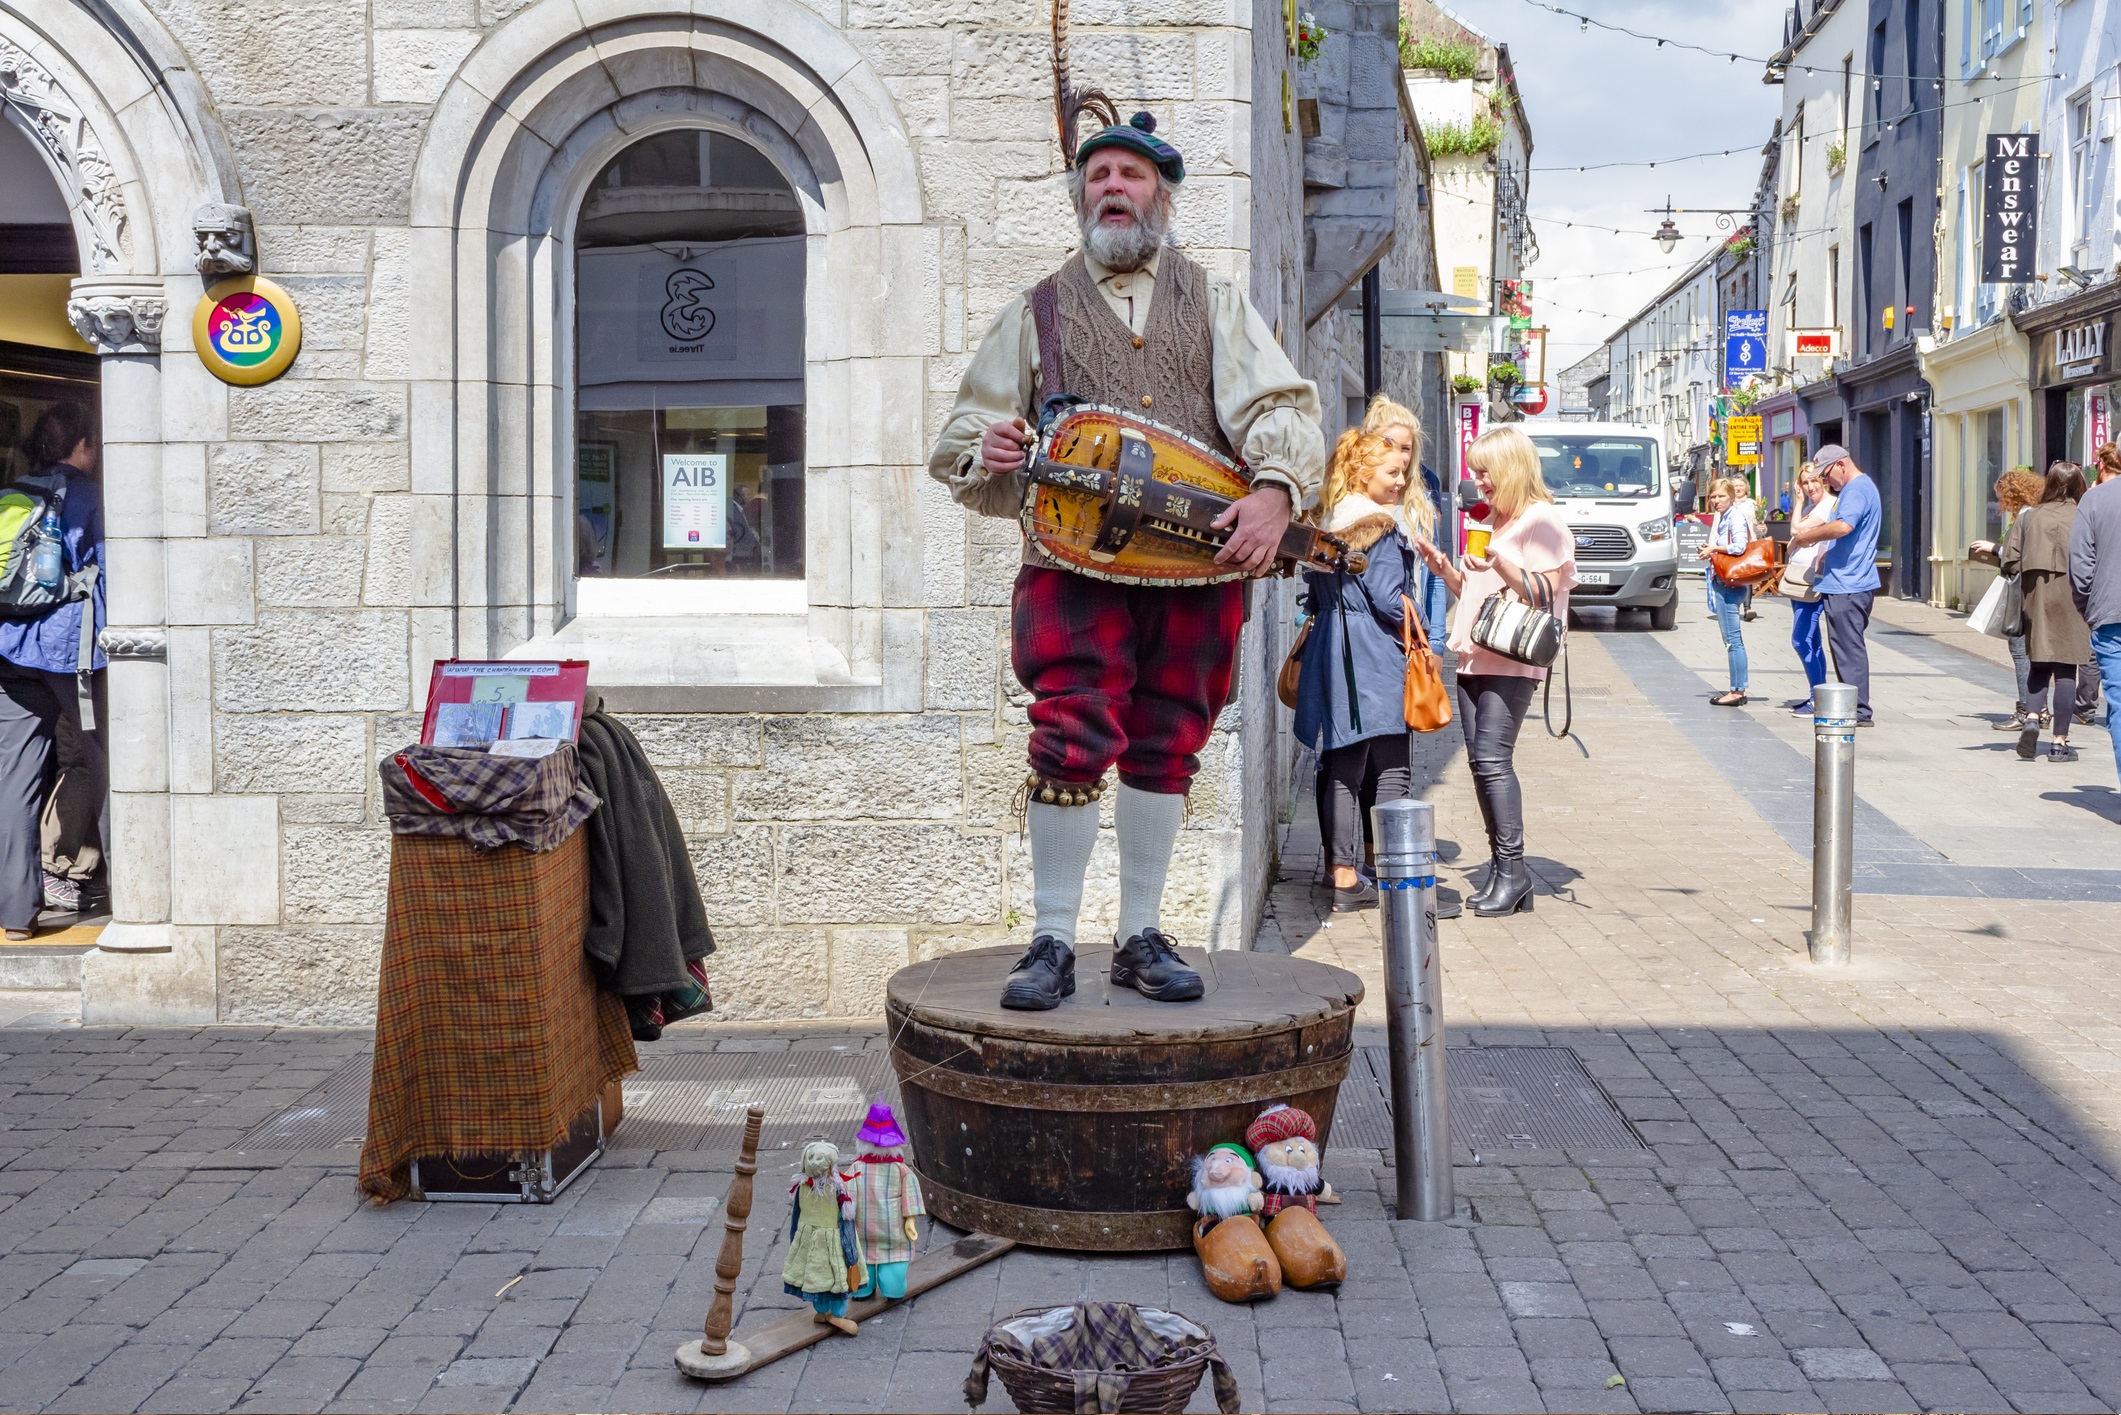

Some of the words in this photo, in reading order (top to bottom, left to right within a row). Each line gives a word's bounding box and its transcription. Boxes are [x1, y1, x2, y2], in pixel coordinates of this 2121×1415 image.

[1996, 137, 2030, 278] Menswear
[1799, 344, 1829, 352] Adecco
[2055, 322, 2106, 365] LALLY
[2062, 364, 2098, 379] Menswear
[672, 467, 716, 487] AIB
[490, 686, 504, 702] 5
